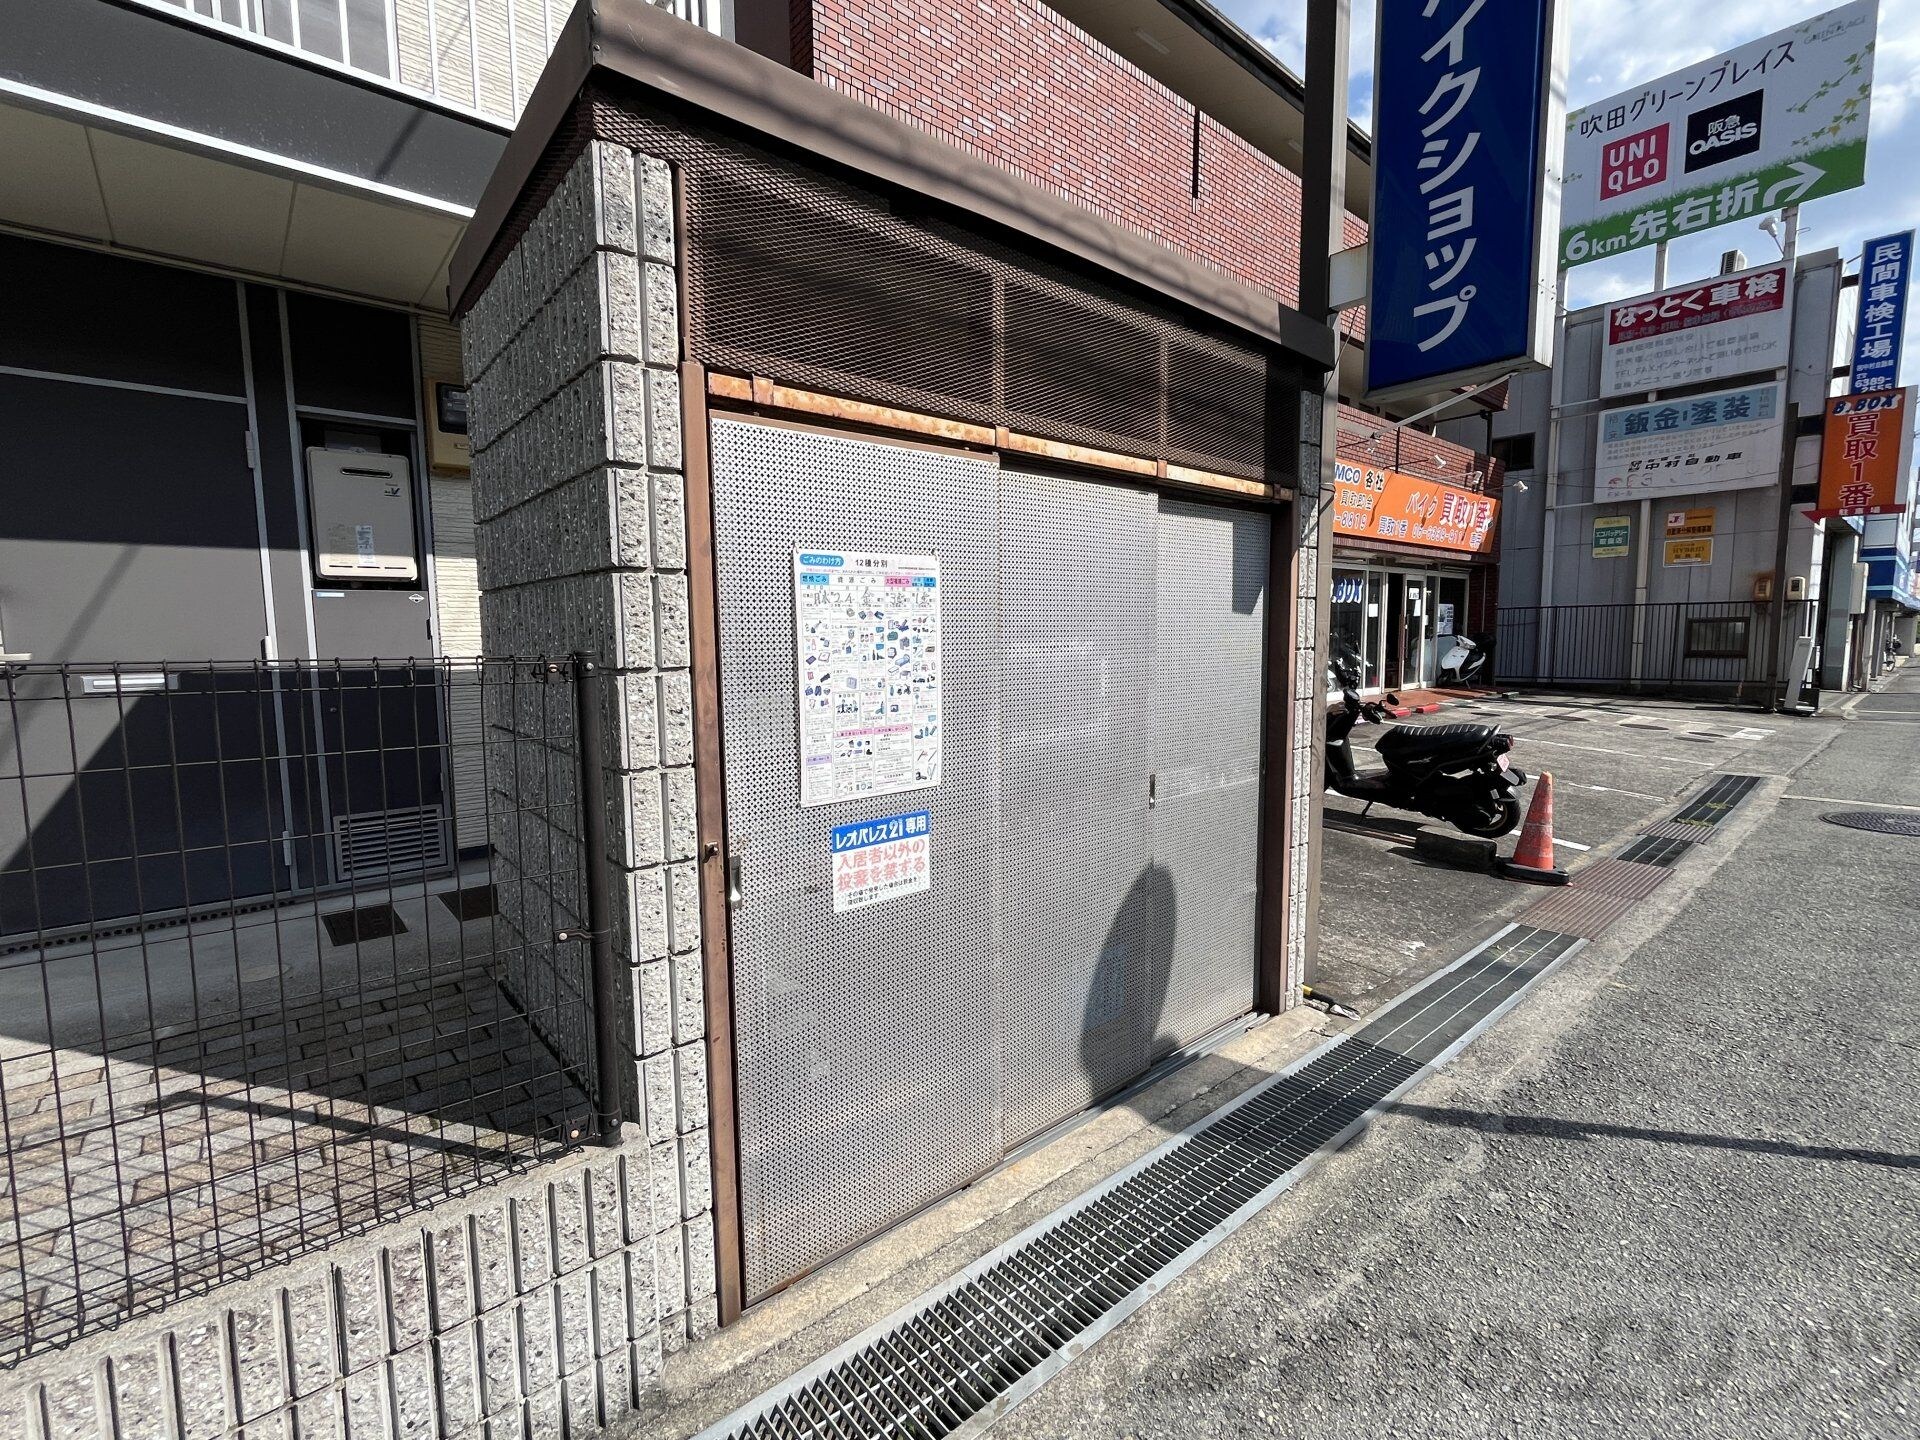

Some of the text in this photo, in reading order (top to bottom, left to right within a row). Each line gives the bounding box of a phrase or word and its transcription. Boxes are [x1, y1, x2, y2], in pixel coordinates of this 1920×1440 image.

[1580, 41, 1795, 139] 吹田グリーンプレイス
[1689, 122, 1758, 155] OASIS
[1708, 115, 1740, 136] 阪急
[1609, 136, 1657, 167] UNI
[1413, 0, 1486, 353] イクショップ
[1608, 158, 1660, 191] QLO
[1615, 273, 1780, 327] なっとく車検
[1862, 241, 1902, 359] 民間車検工場
[1335, 463, 1360, 484] MCO
[1840, 415, 1879, 507] 買取1番
[1365, 471, 1384, 491] 各社
[1405, 491, 1438, 518] バイク
[803, 555, 841, 566] ごみのわけ方
[1330, 576, 1364, 603] .BOX
[836, 815, 926, 849] レオパレス21専用
[838, 839, 926, 871] 入居者以外の
